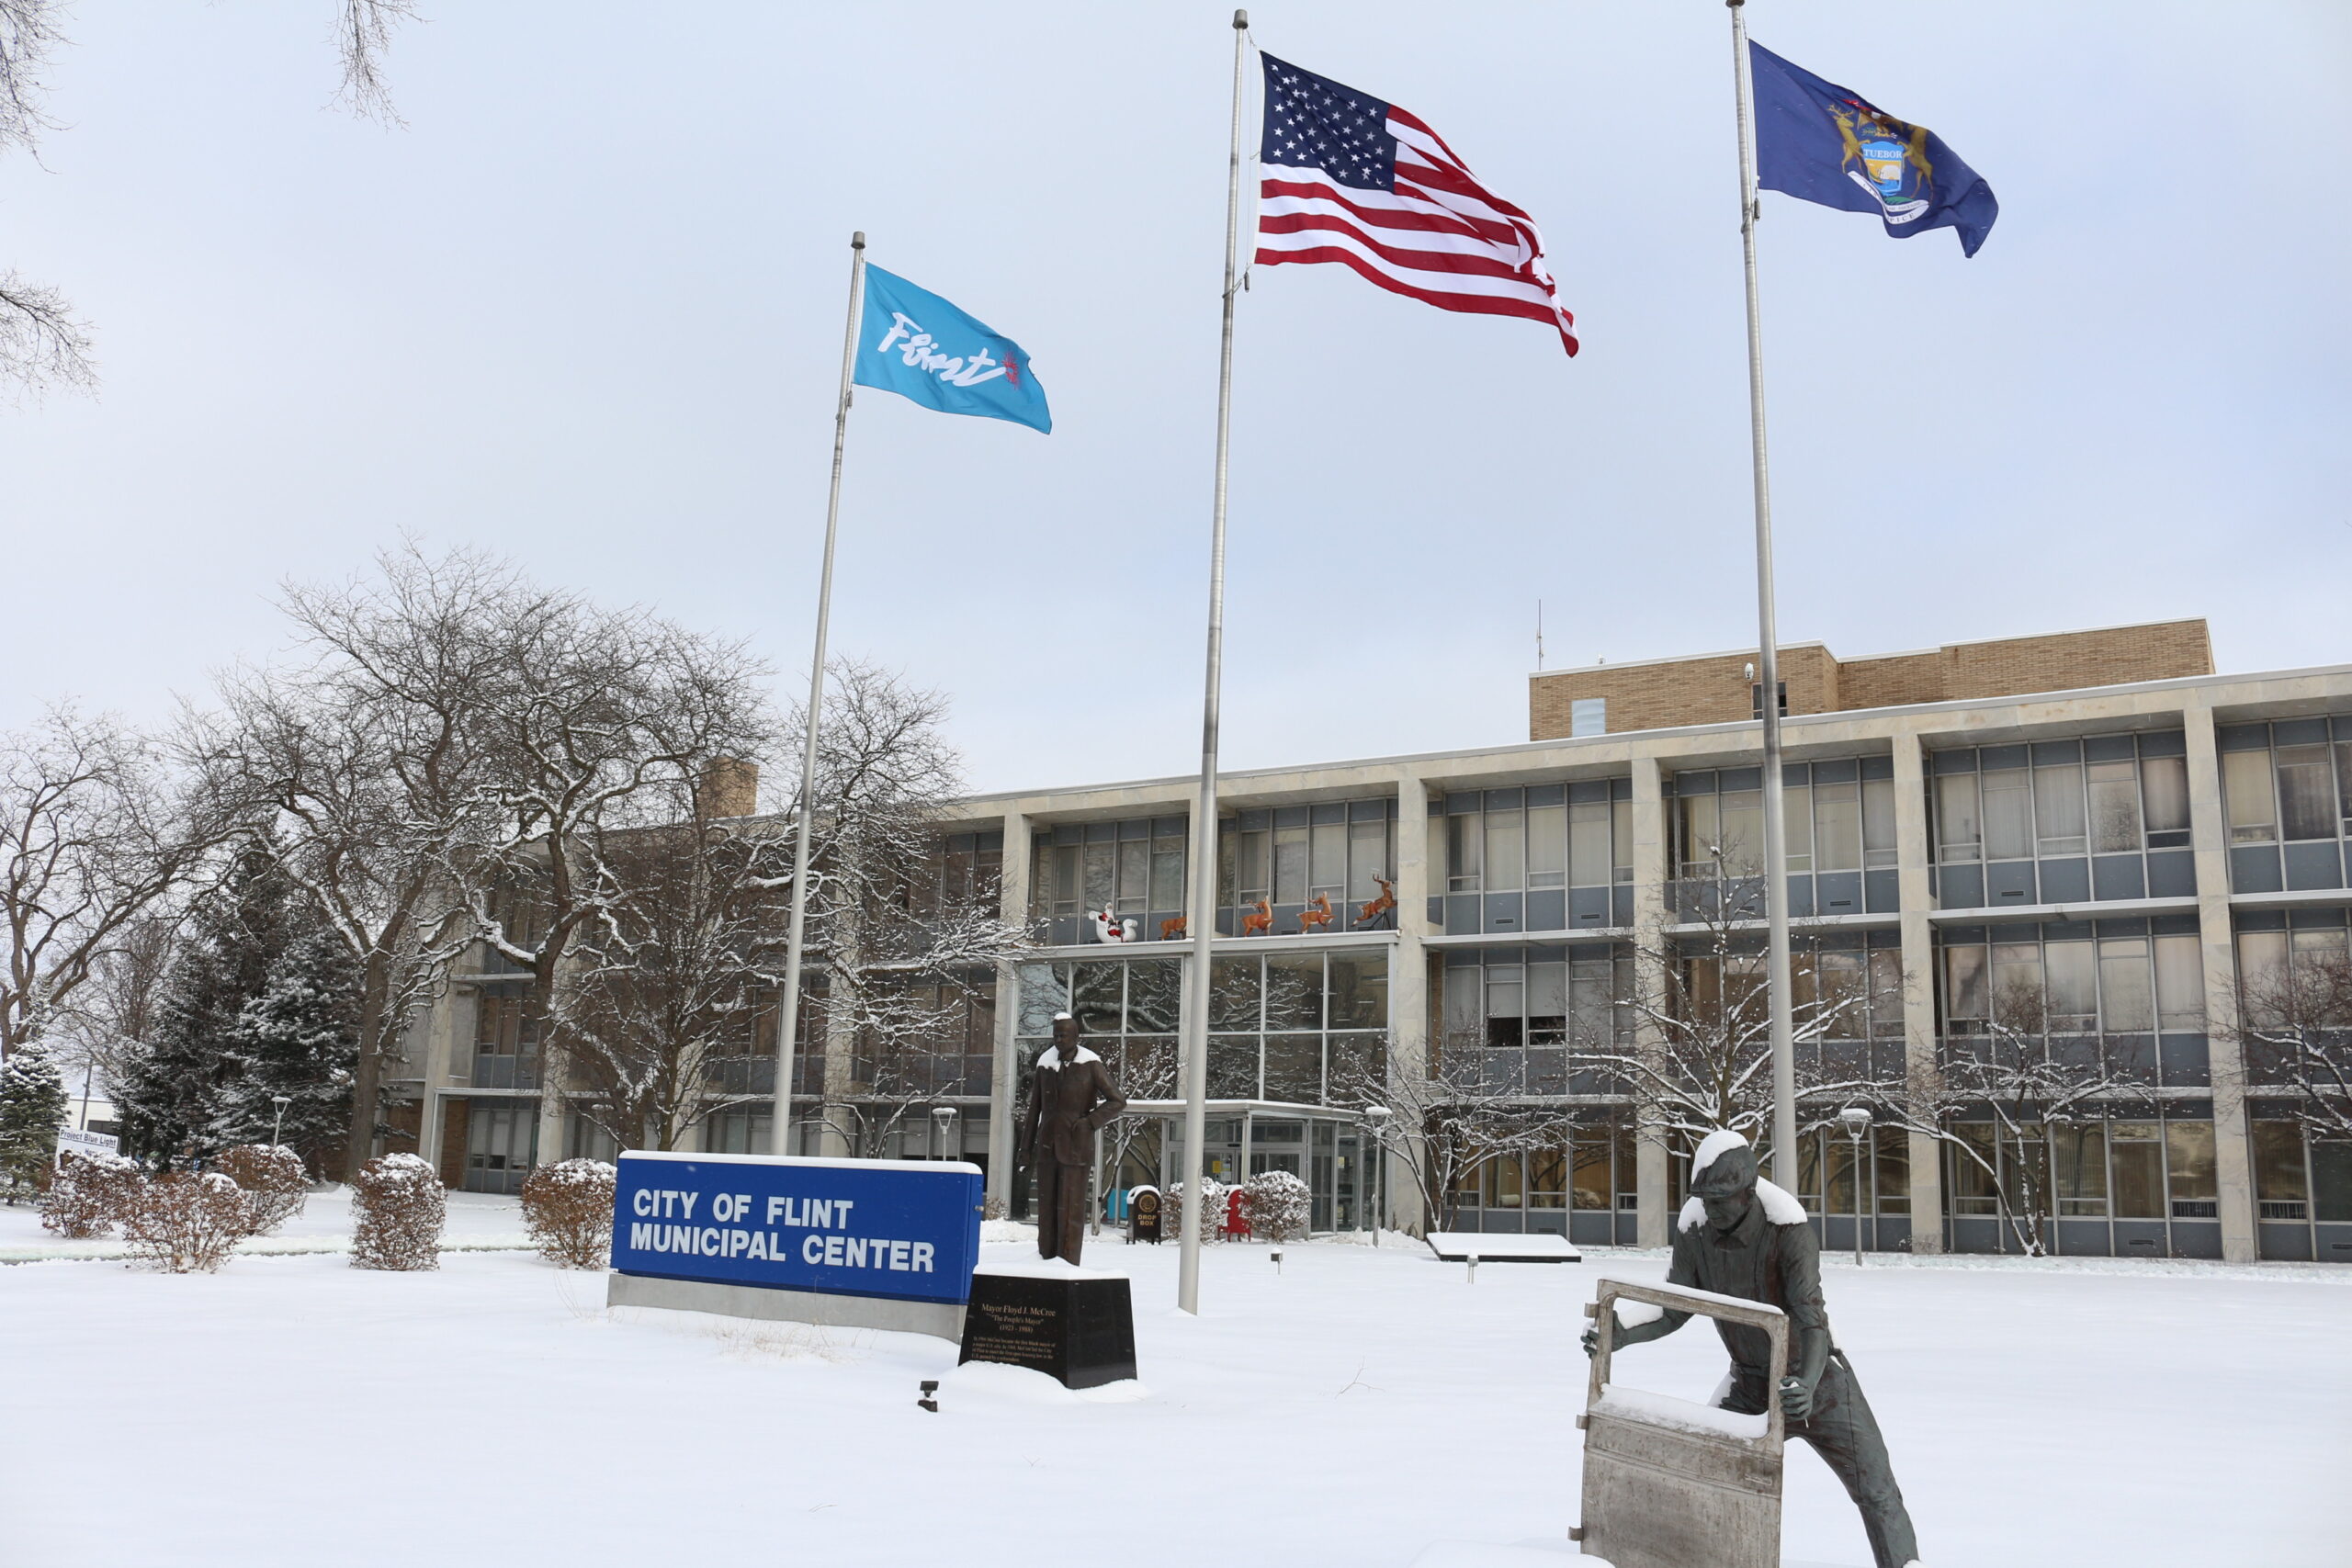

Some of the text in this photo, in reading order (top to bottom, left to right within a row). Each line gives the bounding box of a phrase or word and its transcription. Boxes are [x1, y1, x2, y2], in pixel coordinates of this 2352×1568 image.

[1864, 149, 1903, 158] TUEBOR
[877, 311, 1007, 387] Flint
[60, 1129, 117, 1146] Project Blue Light
[633, 1189, 854, 1230] CITY OF FLINT
[629, 1222, 935, 1273] MUNICIPAL CENTER
[981, 1303, 1002, 1314] Mayor
[1003, 1305, 1022, 1316] Floyd
[1030, 1308, 1056, 1316] McCree
